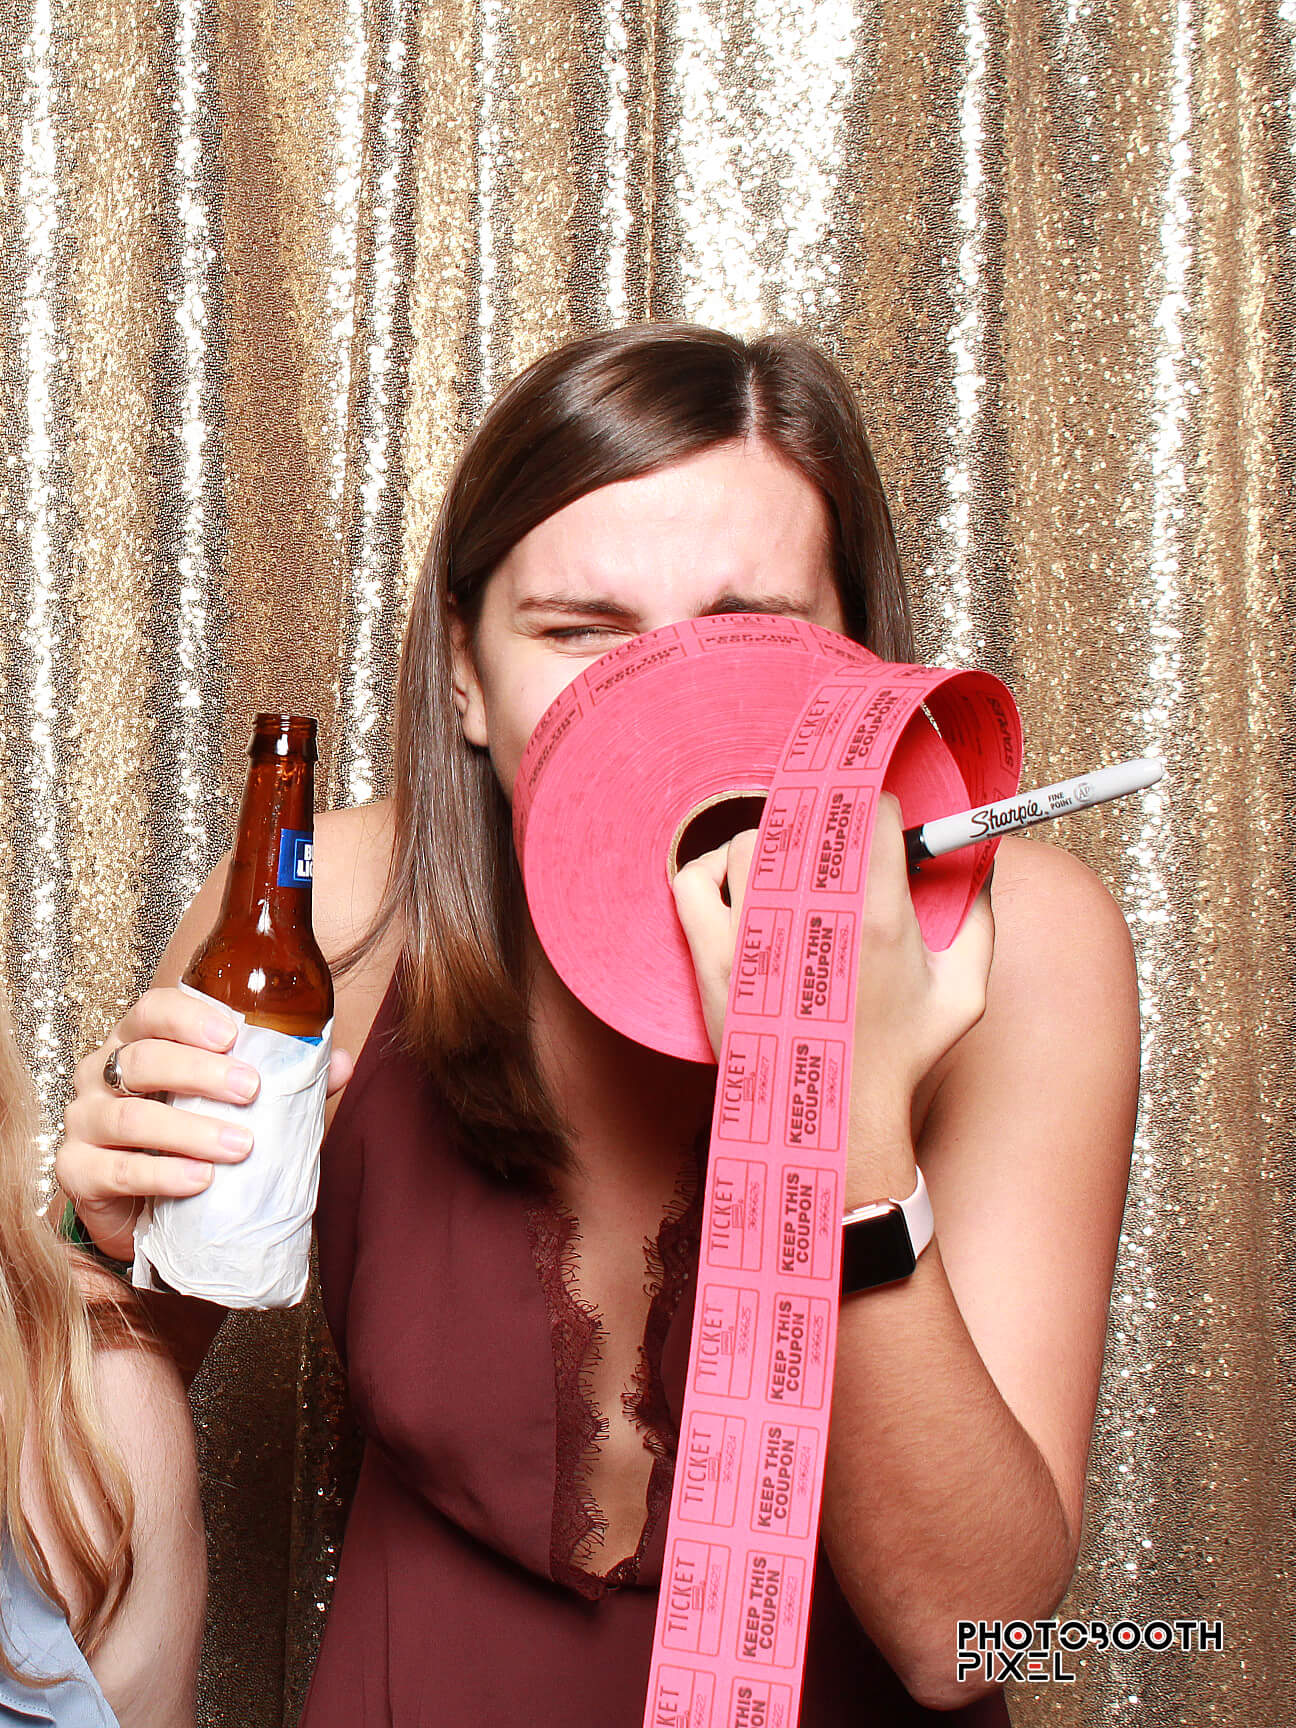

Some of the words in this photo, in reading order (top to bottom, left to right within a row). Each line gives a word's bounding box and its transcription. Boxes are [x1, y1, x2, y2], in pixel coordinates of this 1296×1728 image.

[789, 698, 830, 758] TICKET
[843, 725, 866, 766] KEEP
[866, 690, 891, 719] THIS
[858, 696, 897, 757] COUPON
[970, 798, 1045, 838] Sharpie
[1048, 791, 1064, 803] FINE
[1051, 799, 1073, 810] POINT
[758, 806, 788, 875] TICKET
[816, 840, 833, 888] KEEP
[826, 793, 843, 833] THIS
[830, 802, 851, 879] COUPON
[737, 925, 762, 998] TICKET
[807, 916, 821, 958] THIS
[815, 927, 832, 1006] COUPON
[801, 966, 816, 1015] KEEP
[723, 1050, 746, 1124] TICKET
[795, 1044, 808, 1087] THIS
[805, 1056, 820, 1134] COUPON
[790, 1095, 804, 1143] KEEP
[711, 1177, 733, 1250] TICKET
[786, 1173, 799, 1215] THIS
[797, 1185, 812, 1263] COUPON
[782, 1223, 795, 1271] KEEP
[697, 1304, 723, 1376] TICKET
[777, 1301, 791, 1342] THIS
[771, 1350, 786, 1399] KEEP
[787, 1314, 804, 1391] COUPON
[684, 1428, 711, 1503] TICKET
[764, 1427, 781, 1469] THIS
[758, 1476, 774, 1527] KEEP
[775, 1440, 794, 1519] COUPON
[668, 1557, 695, 1632] TICKET
[750, 1557, 766, 1599] THIS
[743, 1607, 760, 1657] KEEP
[760, 1570, 780, 1649] COUPON
[655, 1685, 679, 1728] KET
[735, 1687, 752, 1728] THIS
